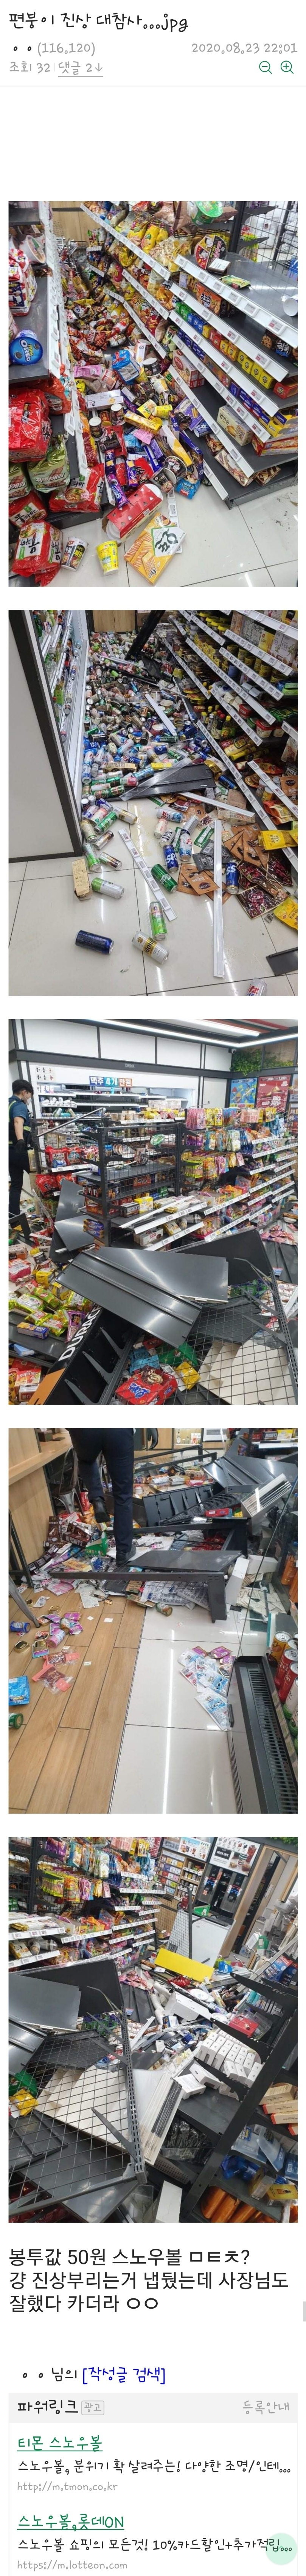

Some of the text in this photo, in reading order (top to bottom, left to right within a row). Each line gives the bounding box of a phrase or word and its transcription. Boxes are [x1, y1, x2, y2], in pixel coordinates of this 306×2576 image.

[19, 338, 31, 362] OREO
[219, 413, 230, 425] 엄마손
[35, 473, 65, 483] 짜파게티
[112, 486, 121, 499] OREO
[143, 937, 155, 954] Kloud
[90, 1077, 104, 1085] 맥주
[119, 1078, 132, 1086] 만원
[65, 1536, 83, 1547] HERSHEY'S
[48, 1544, 57, 1554] HERSHEY'S
